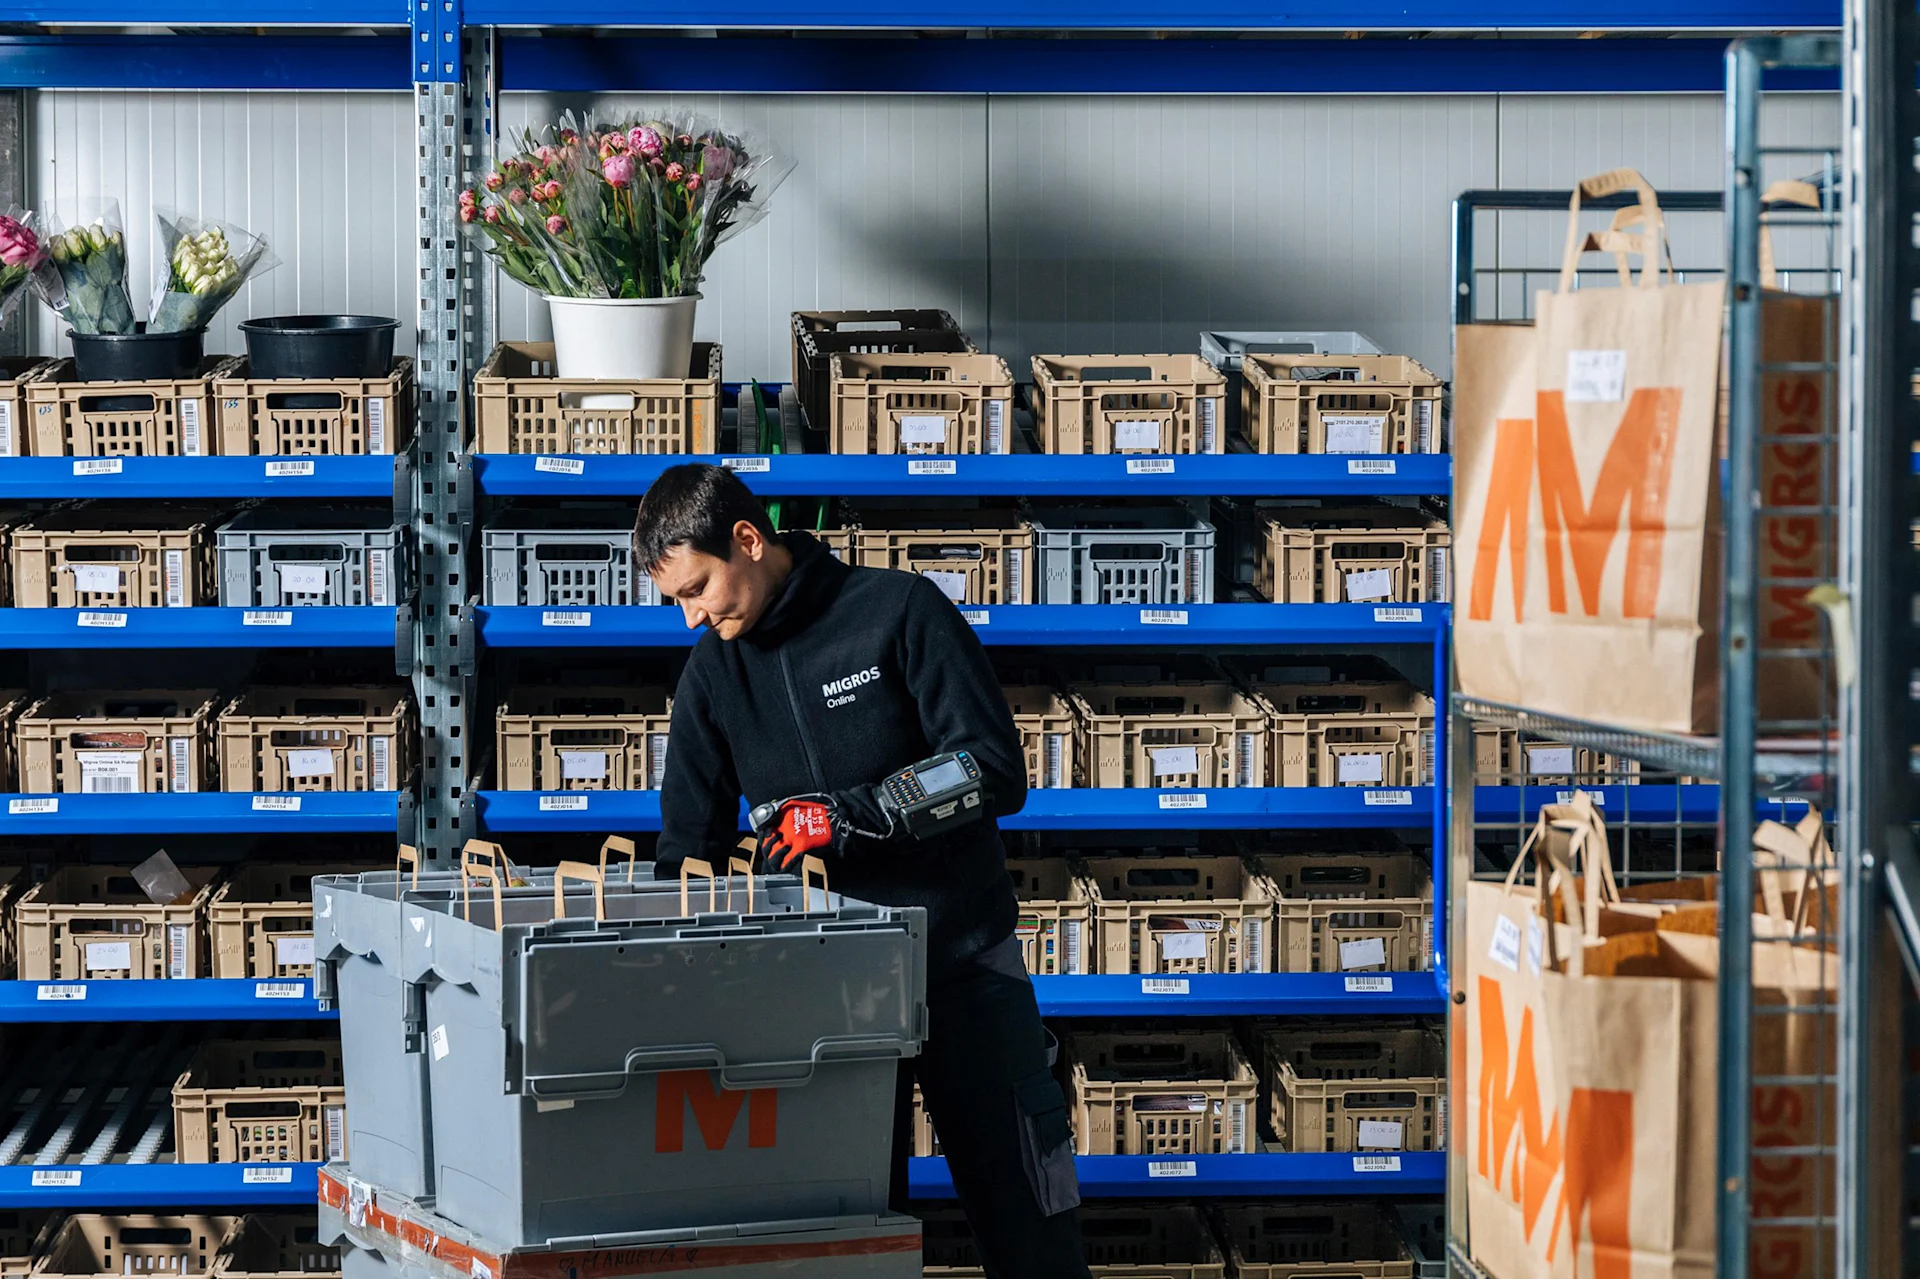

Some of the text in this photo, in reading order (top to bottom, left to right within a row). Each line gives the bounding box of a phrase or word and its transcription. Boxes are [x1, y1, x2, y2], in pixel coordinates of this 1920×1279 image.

[224, 397, 238, 409] 155
[1536, 387, 1683, 619] M
[1767, 379, 1821, 641] MIGROS
[822, 666, 881, 698] MIGROS
[826, 694, 856, 708] Online
[655, 1069, 778, 1154] M
